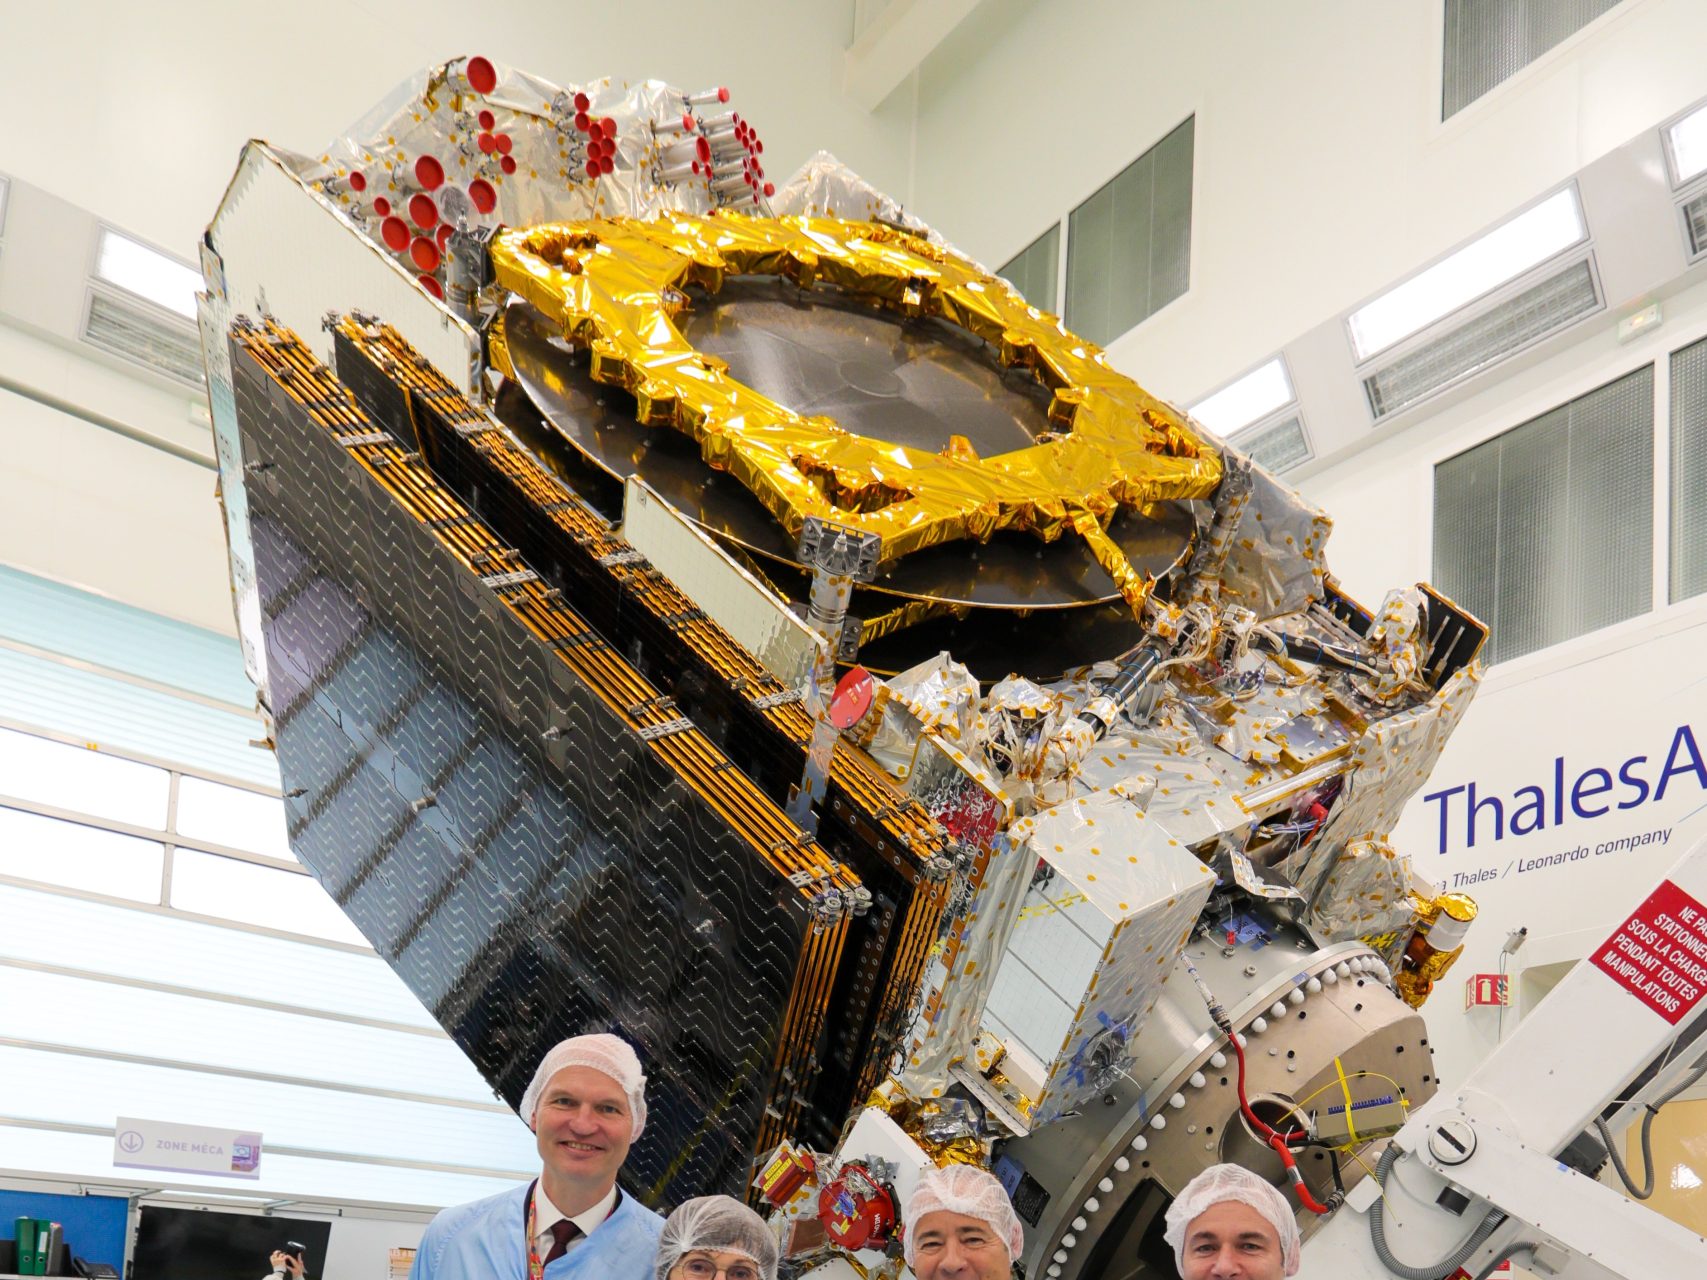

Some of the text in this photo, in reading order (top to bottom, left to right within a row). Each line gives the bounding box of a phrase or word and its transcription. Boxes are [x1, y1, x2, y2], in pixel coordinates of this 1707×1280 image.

[1424, 724, 1707, 854] ThalesA
[1453, 867, 1497, 888] Thales
[1518, 846, 1589, 873] Leonardo
[1595, 828, 1672, 855] company
[1627, 919, 1707, 986] SOUS LA CHARGE
[1678, 906, 1707, 938] NE PA
[1602, 950, 1680, 1013] MANIPULATIONS
[1613, 933, 1698, 1000] PENDANT TOUTES
[157, 1139, 187, 1152] ZONE
